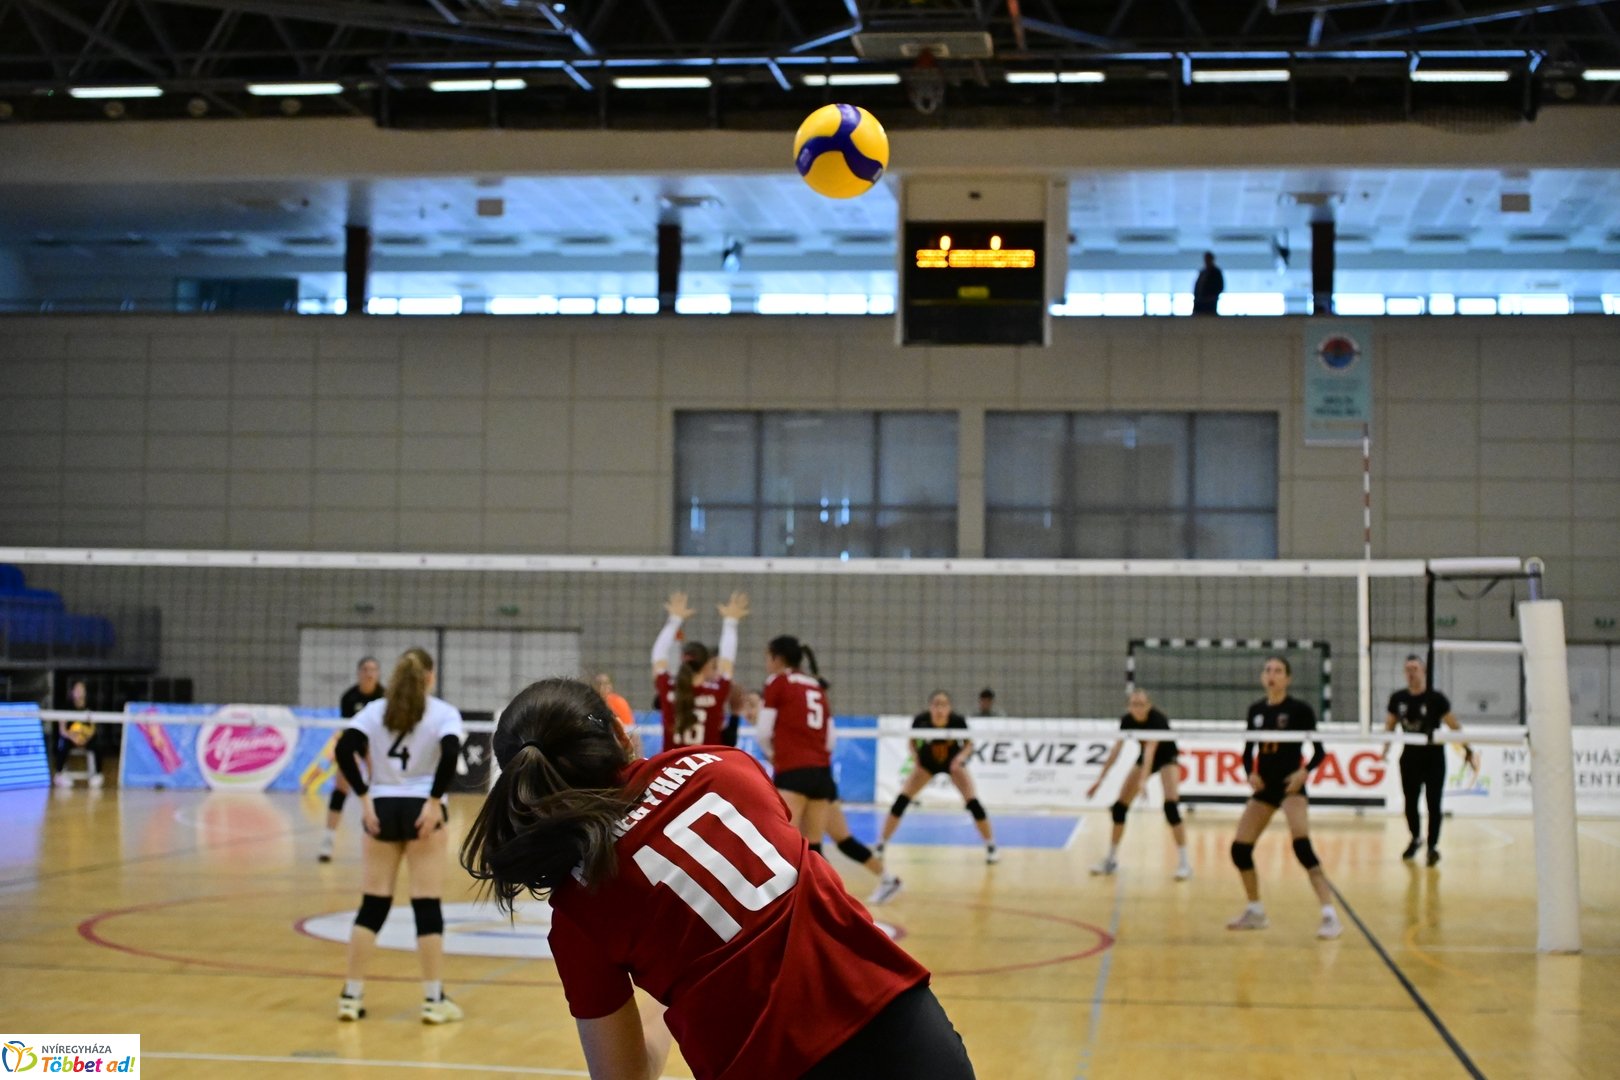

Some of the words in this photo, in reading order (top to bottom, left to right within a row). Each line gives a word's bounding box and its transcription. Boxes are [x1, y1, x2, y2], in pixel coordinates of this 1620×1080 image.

[806, 689, 823, 730] 5
[388, 731, 411, 770] 4
[632, 792, 799, 943] 10
